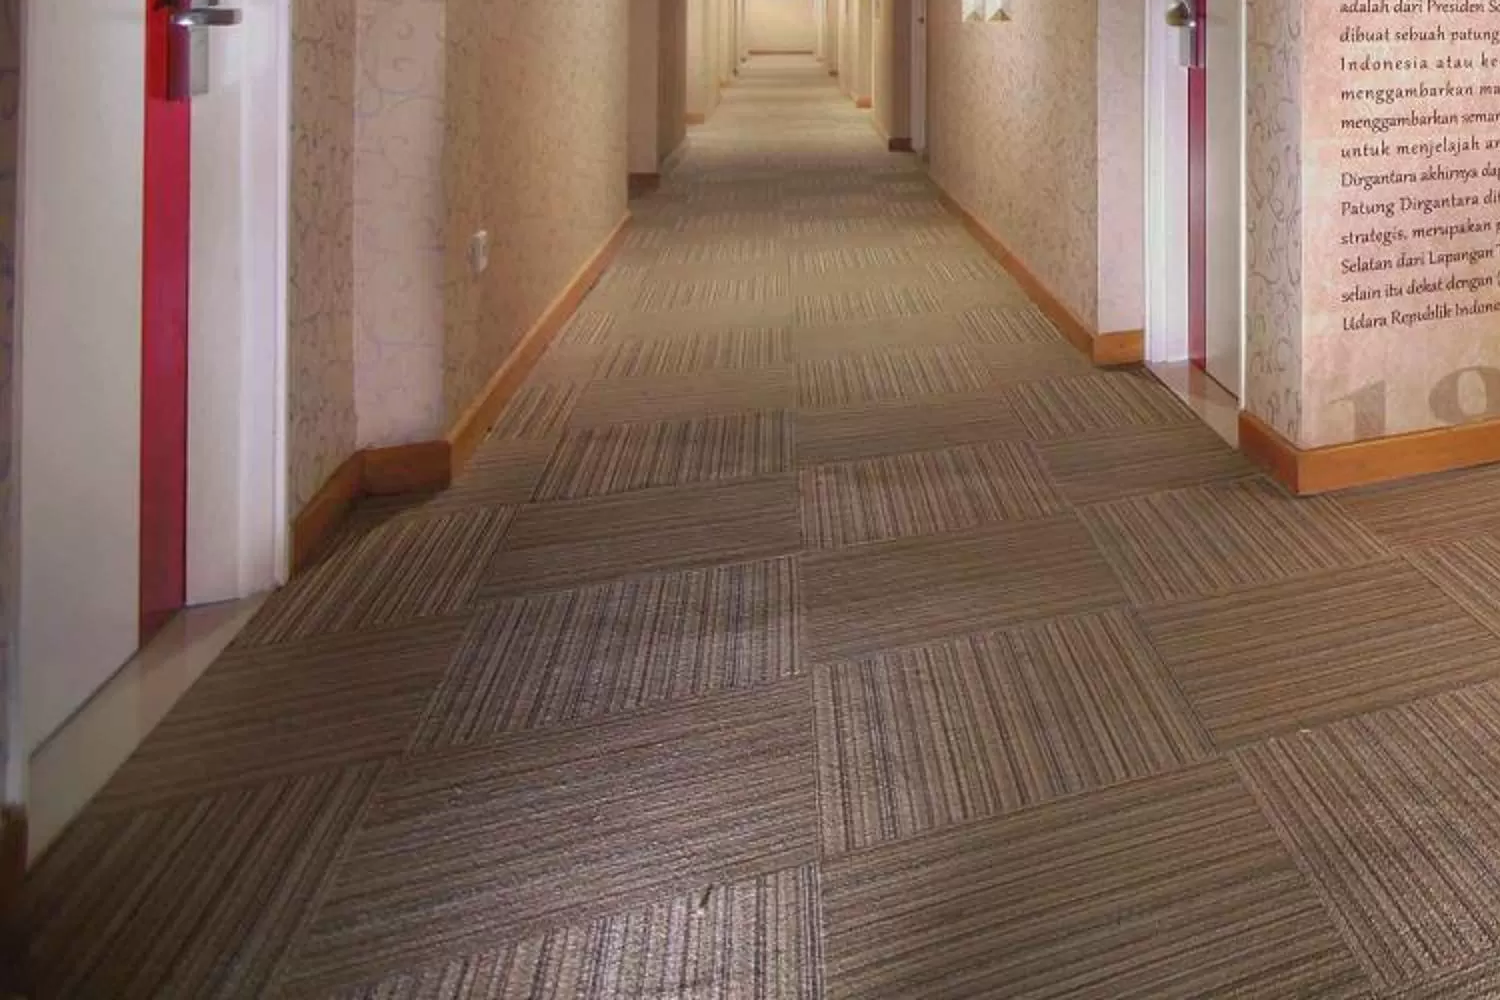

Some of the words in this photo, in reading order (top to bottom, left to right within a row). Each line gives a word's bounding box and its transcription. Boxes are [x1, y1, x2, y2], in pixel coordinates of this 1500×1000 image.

[1339, 25, 1389, 43] dibuat
[1395, 25, 1445, 42] sebuah
[1450, 27, 1500, 45] patung
[1341, 53, 1428, 71] Indonesia
[1435, 56, 1473, 69] atau
[1341, 80, 1473, 104] menggambarkan
[1341, 109, 1458, 133] menggambarkan
[1341, 140, 1390, 159] untuk
[1396, 134, 1480, 158] menjelajah
[1341, 169, 1416, 190] Dirgantara
[1420, 164, 1478, 183] akhirnya
[1341, 201, 1395, 217] Patung
[1400, 195, 1479, 214] Dirgantara
[1412, 218, 1491, 240] merupakan
[1341, 255, 1393, 274] Selatan
[1396, 252, 1425, 268] dari
[1429, 249, 1494, 269] Lapangan
[1341, 284, 1381, 303] selain
[1406, 277, 1443, 295] dekat
[1446, 274, 1493, 293] dengan
[1343, 313, 1387, 331] Udara
[1391, 303, 1452, 327] Republik
